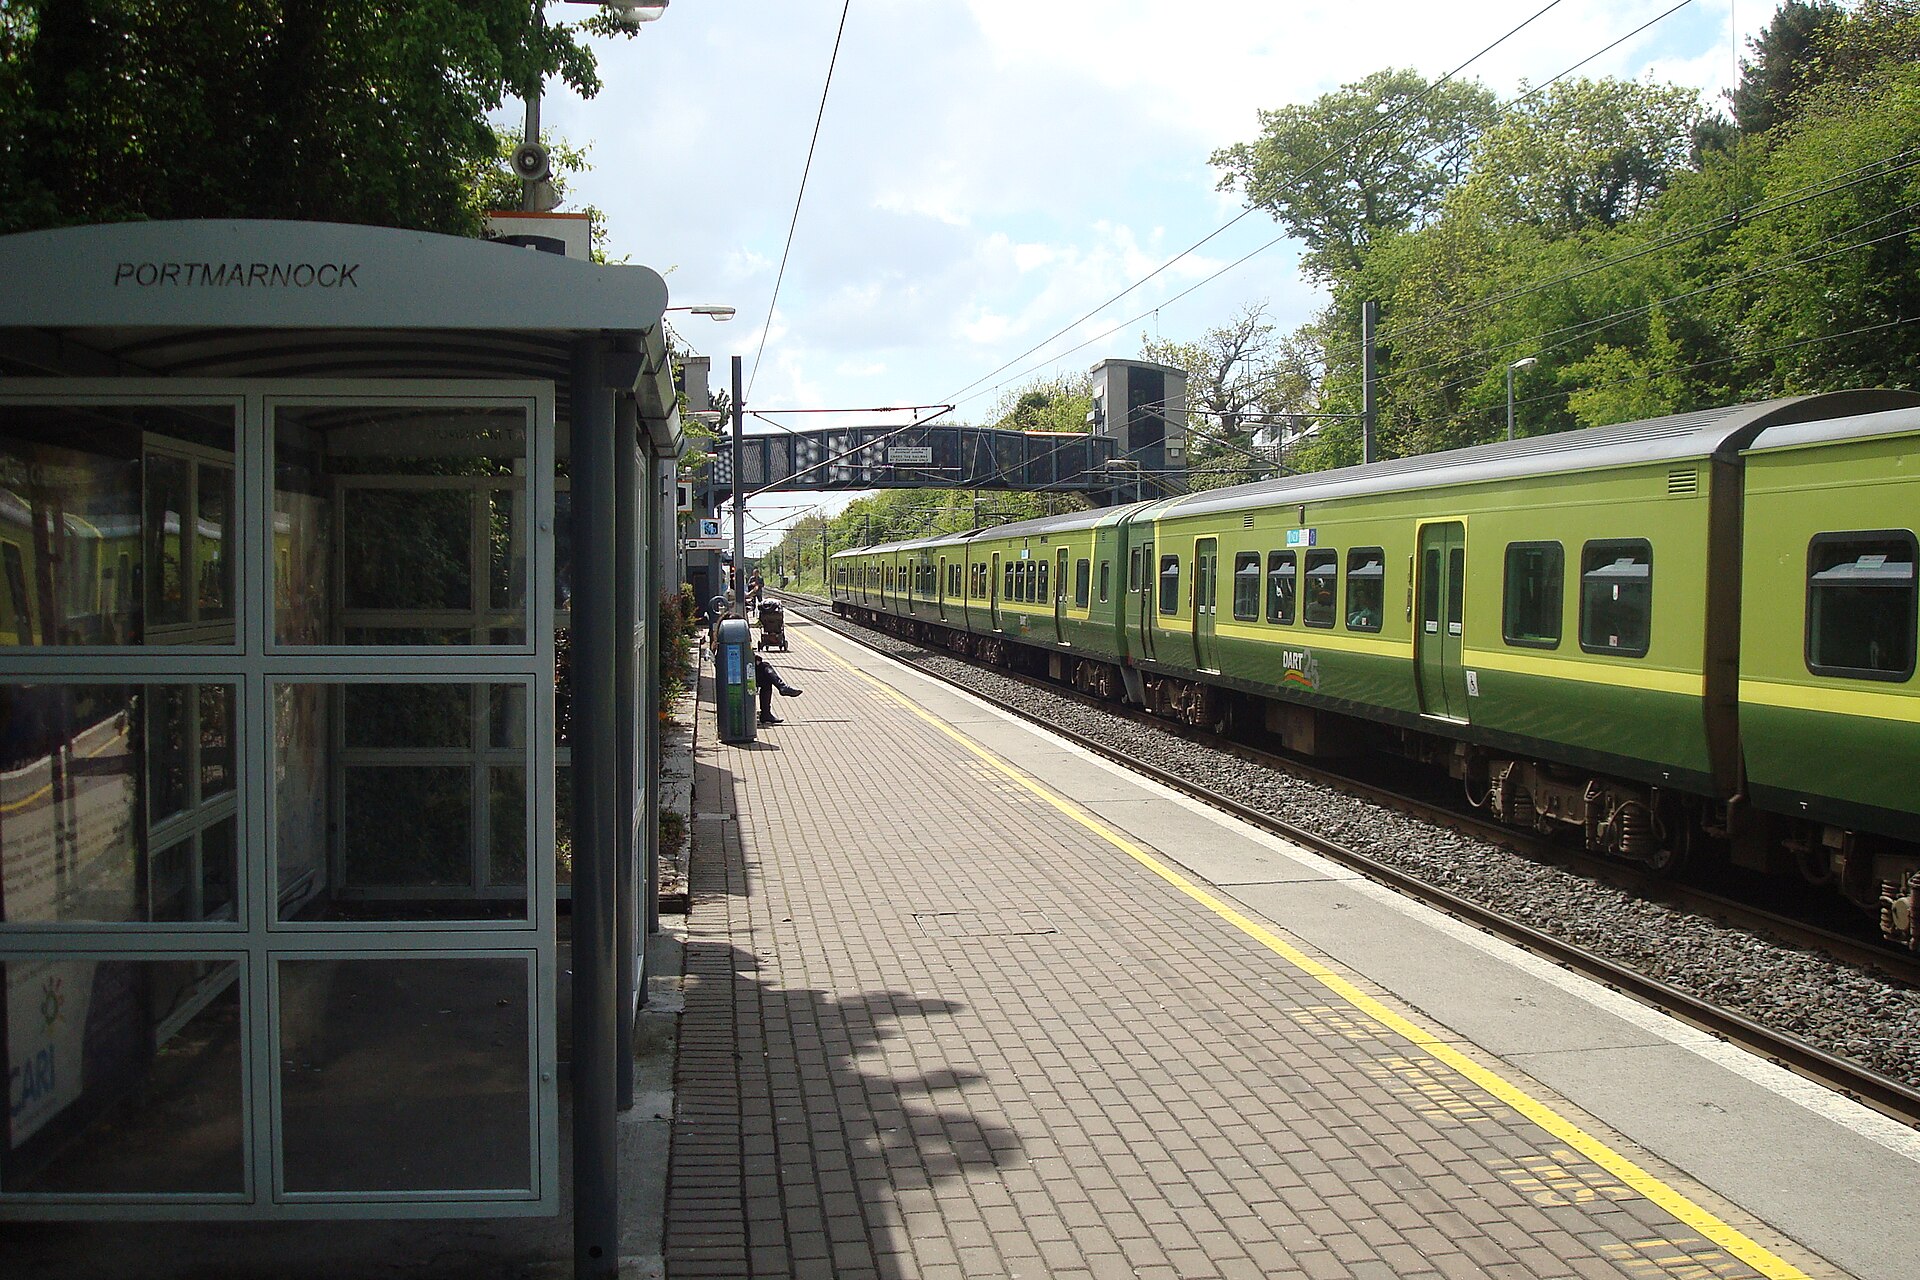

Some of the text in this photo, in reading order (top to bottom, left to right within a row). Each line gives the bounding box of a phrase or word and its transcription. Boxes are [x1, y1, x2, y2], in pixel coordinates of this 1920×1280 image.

[113, 262, 361, 288] PORTMARNOCK
[1282, 647, 1320, 690] DART 25
[1356, 1056, 1511, 1122] BEHIND
[1485, 1149, 1635, 1206] THIS
[1599, 1237, 1762, 1280] LIN
